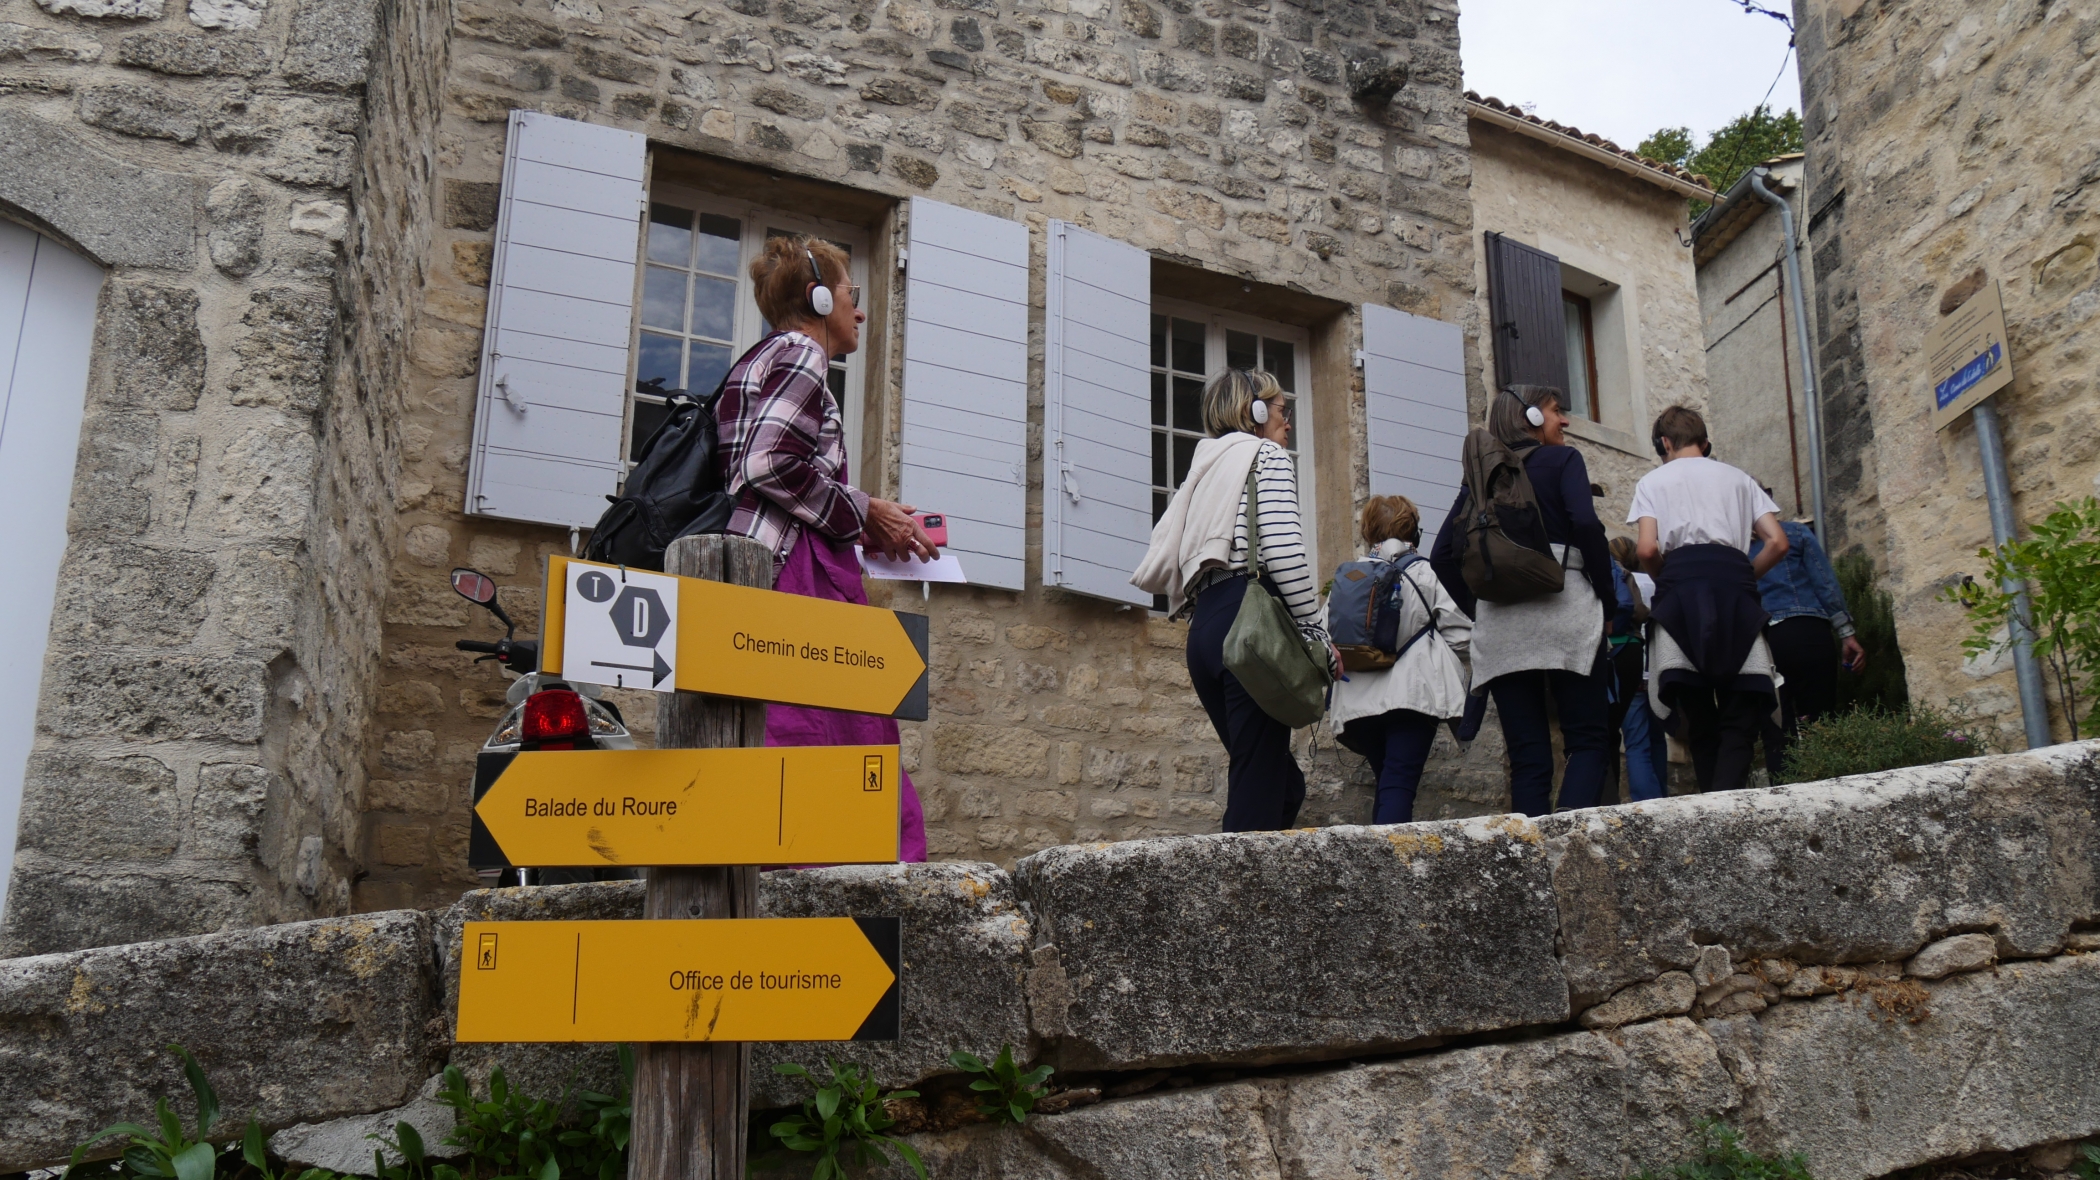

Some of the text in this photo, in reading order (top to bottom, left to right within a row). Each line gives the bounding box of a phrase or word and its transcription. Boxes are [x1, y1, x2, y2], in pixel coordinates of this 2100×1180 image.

[592, 576, 601, 598] T
[633, 596, 649, 638] D
[733, 632, 885, 669] Chemin des Etoiles
[525, 797, 677, 816] Balade du Roure
[669, 969, 841, 990] Office de tourisme
